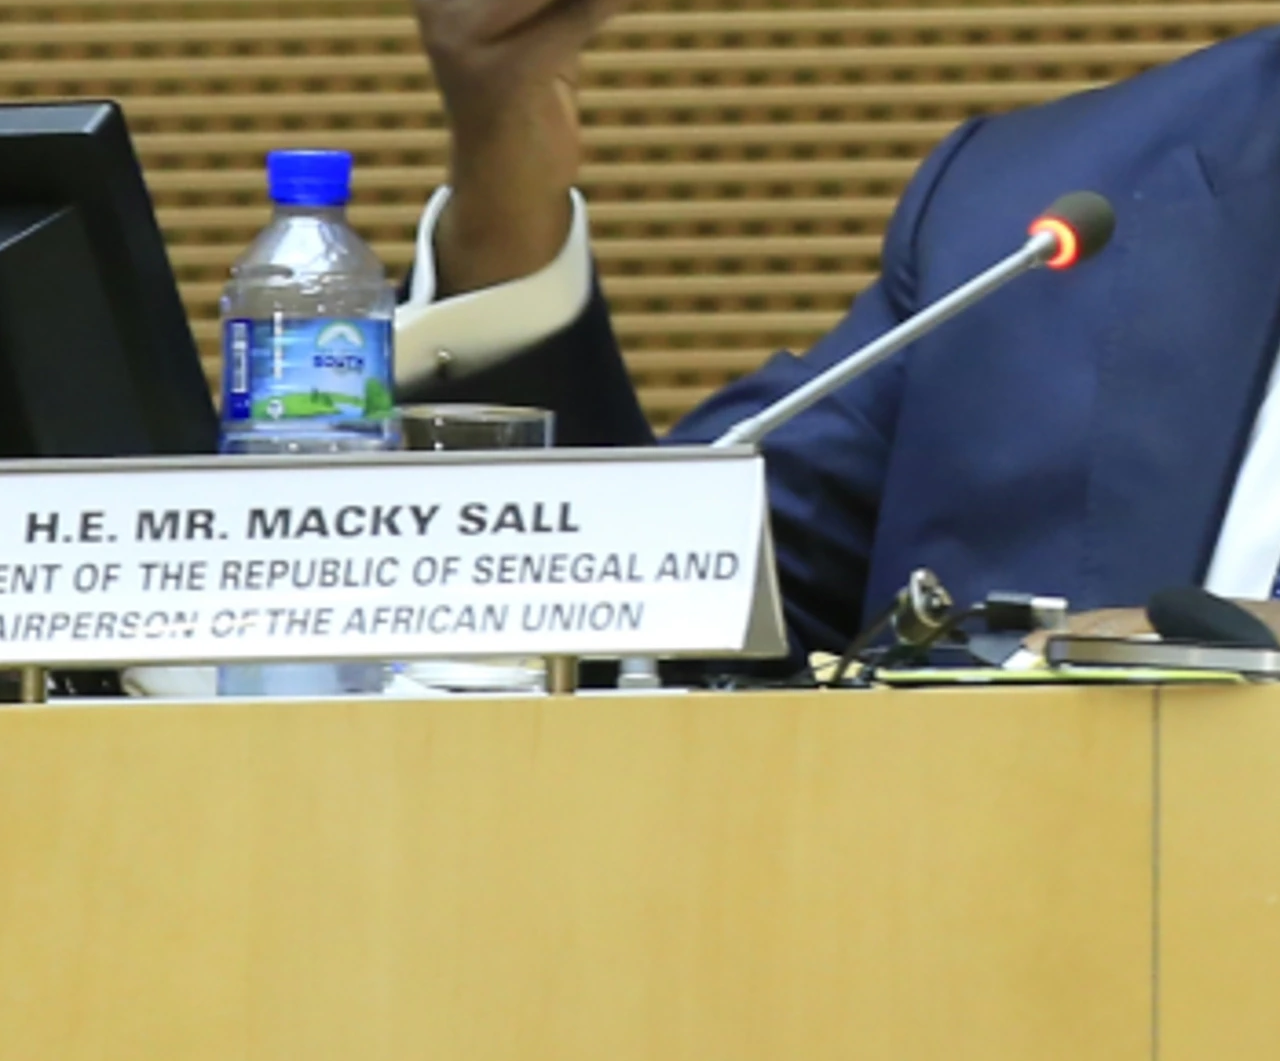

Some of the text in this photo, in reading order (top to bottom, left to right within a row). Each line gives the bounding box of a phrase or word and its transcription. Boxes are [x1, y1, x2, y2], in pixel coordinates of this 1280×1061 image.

[25, 501, 581, 544] H.E. MR. MACKY SALL
[73, 562, 122, 594] OF
[139, 560, 207, 591] THE
[219, 556, 400, 591] REPUBLIC
[412, 555, 461, 587] OF
[471, 552, 645, 585] SENEGAL
[654, 549, 740, 583] AND
[211, 608, 260, 639] OF
[265, 606, 334, 636] THE
[341, 603, 510, 636] AFRICAN
[520, 601, 645, 633] UNION
